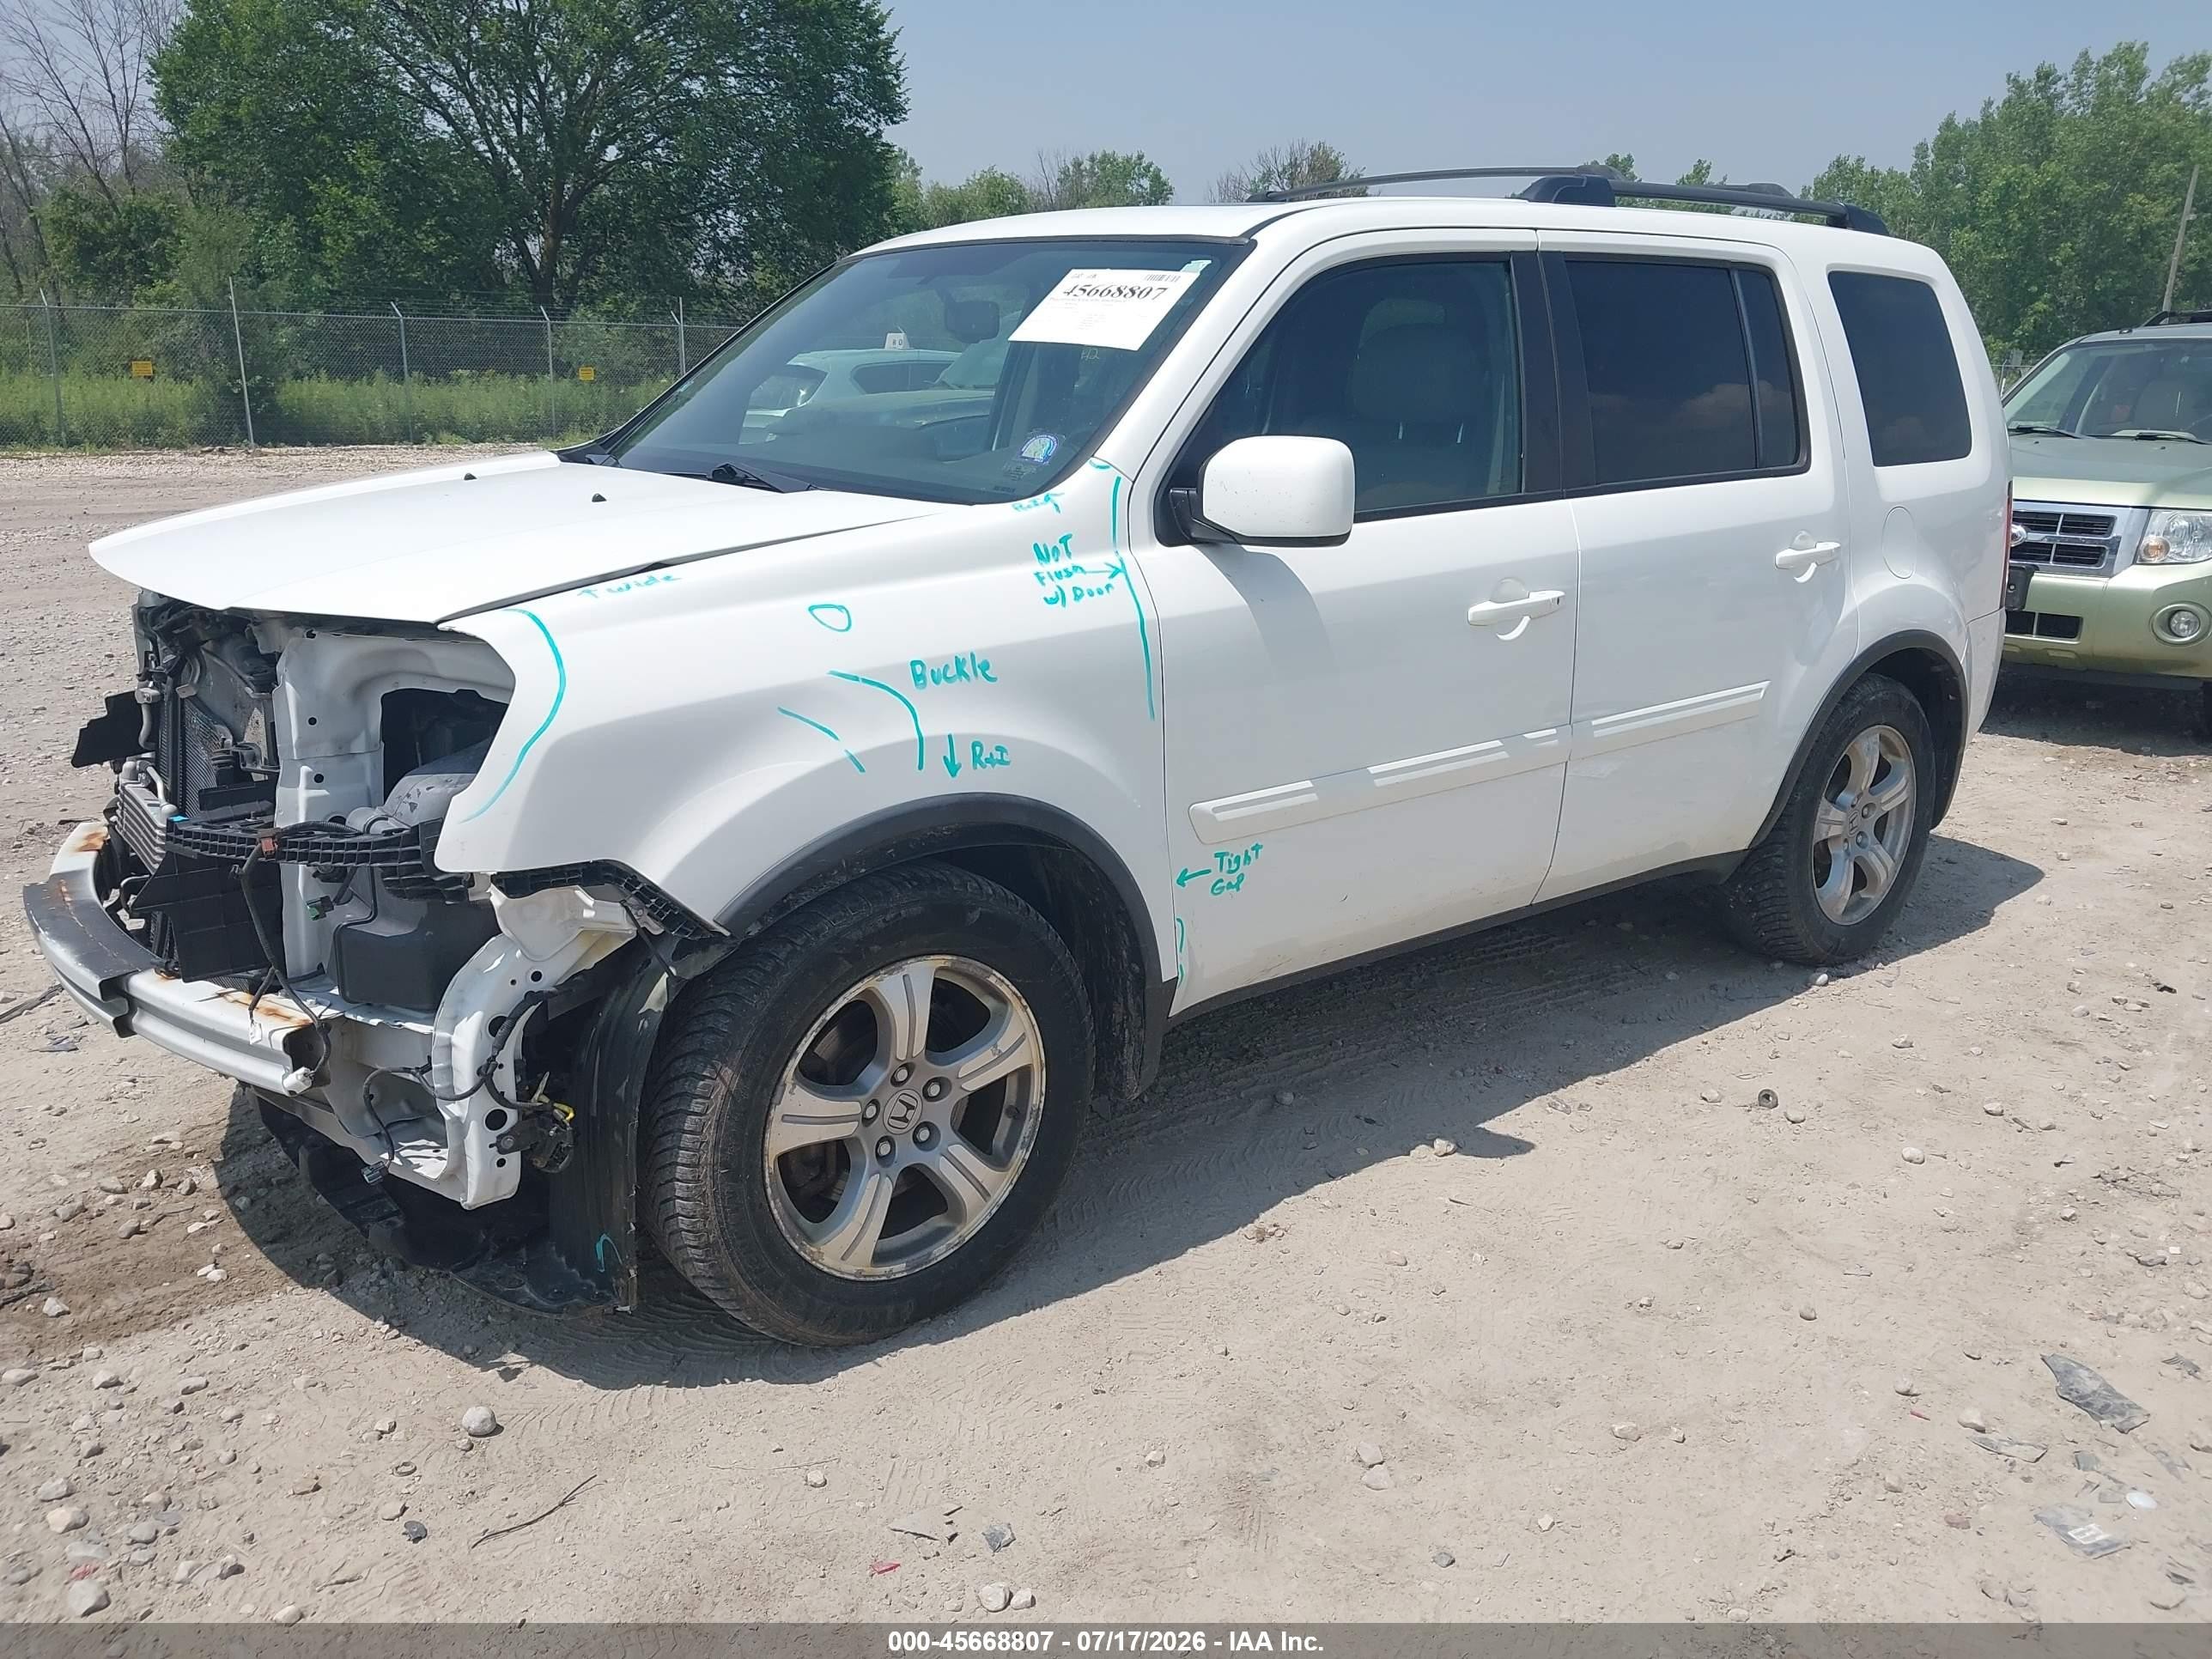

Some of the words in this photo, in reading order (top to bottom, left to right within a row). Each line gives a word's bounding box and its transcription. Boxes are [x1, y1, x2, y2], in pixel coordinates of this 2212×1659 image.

[1063, 283, 1169, 300] 45668807
[1072, 583, 1115, 602] Door
[909, 652, 998, 690] Buckle
[1213, 842, 1263, 874] Tight
